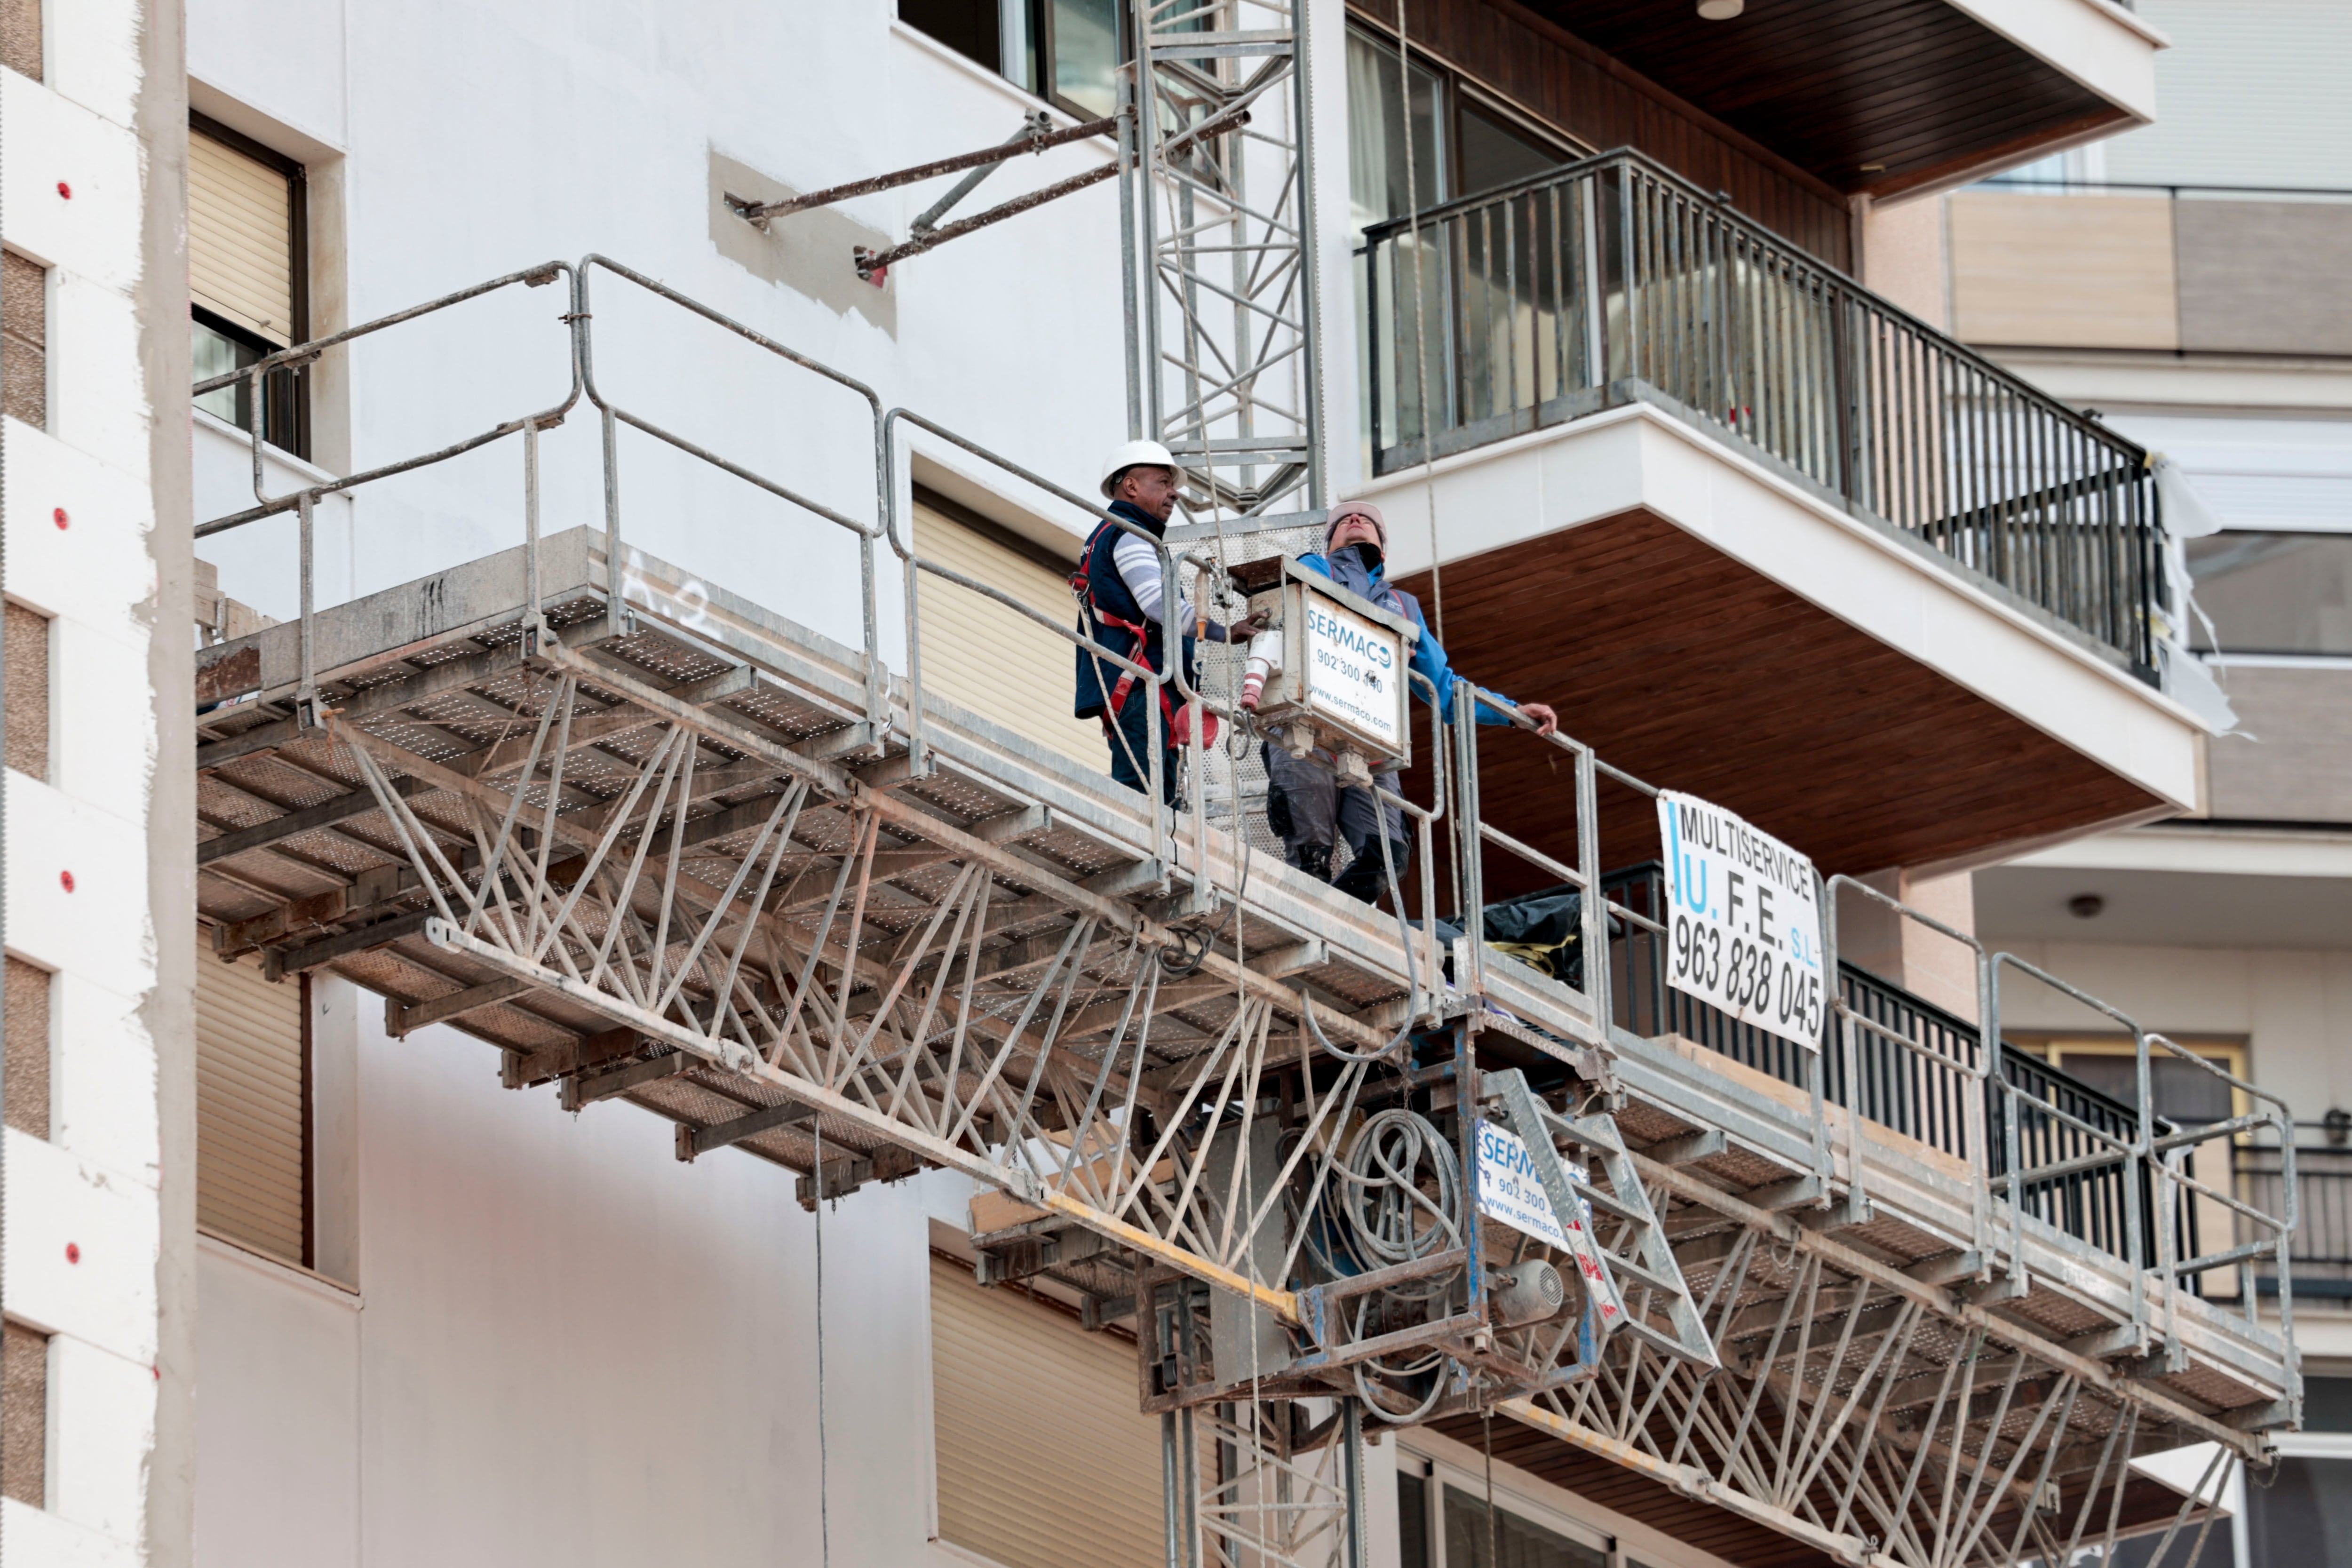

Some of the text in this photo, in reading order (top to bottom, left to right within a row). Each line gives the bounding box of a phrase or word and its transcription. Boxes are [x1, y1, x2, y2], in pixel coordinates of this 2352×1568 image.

[1308, 609, 1391, 669] SERMACO
[1317, 649, 1336, 670] 902
[1341, 661, 1359, 682] 300
[1310, 685, 1391, 732] www.sermaco.com
[1680, 804, 1810, 902] MULTISERVICE
[1676, 915, 1819, 1037] 963 838 045
[1499, 1178, 1545, 1211] 902 300
